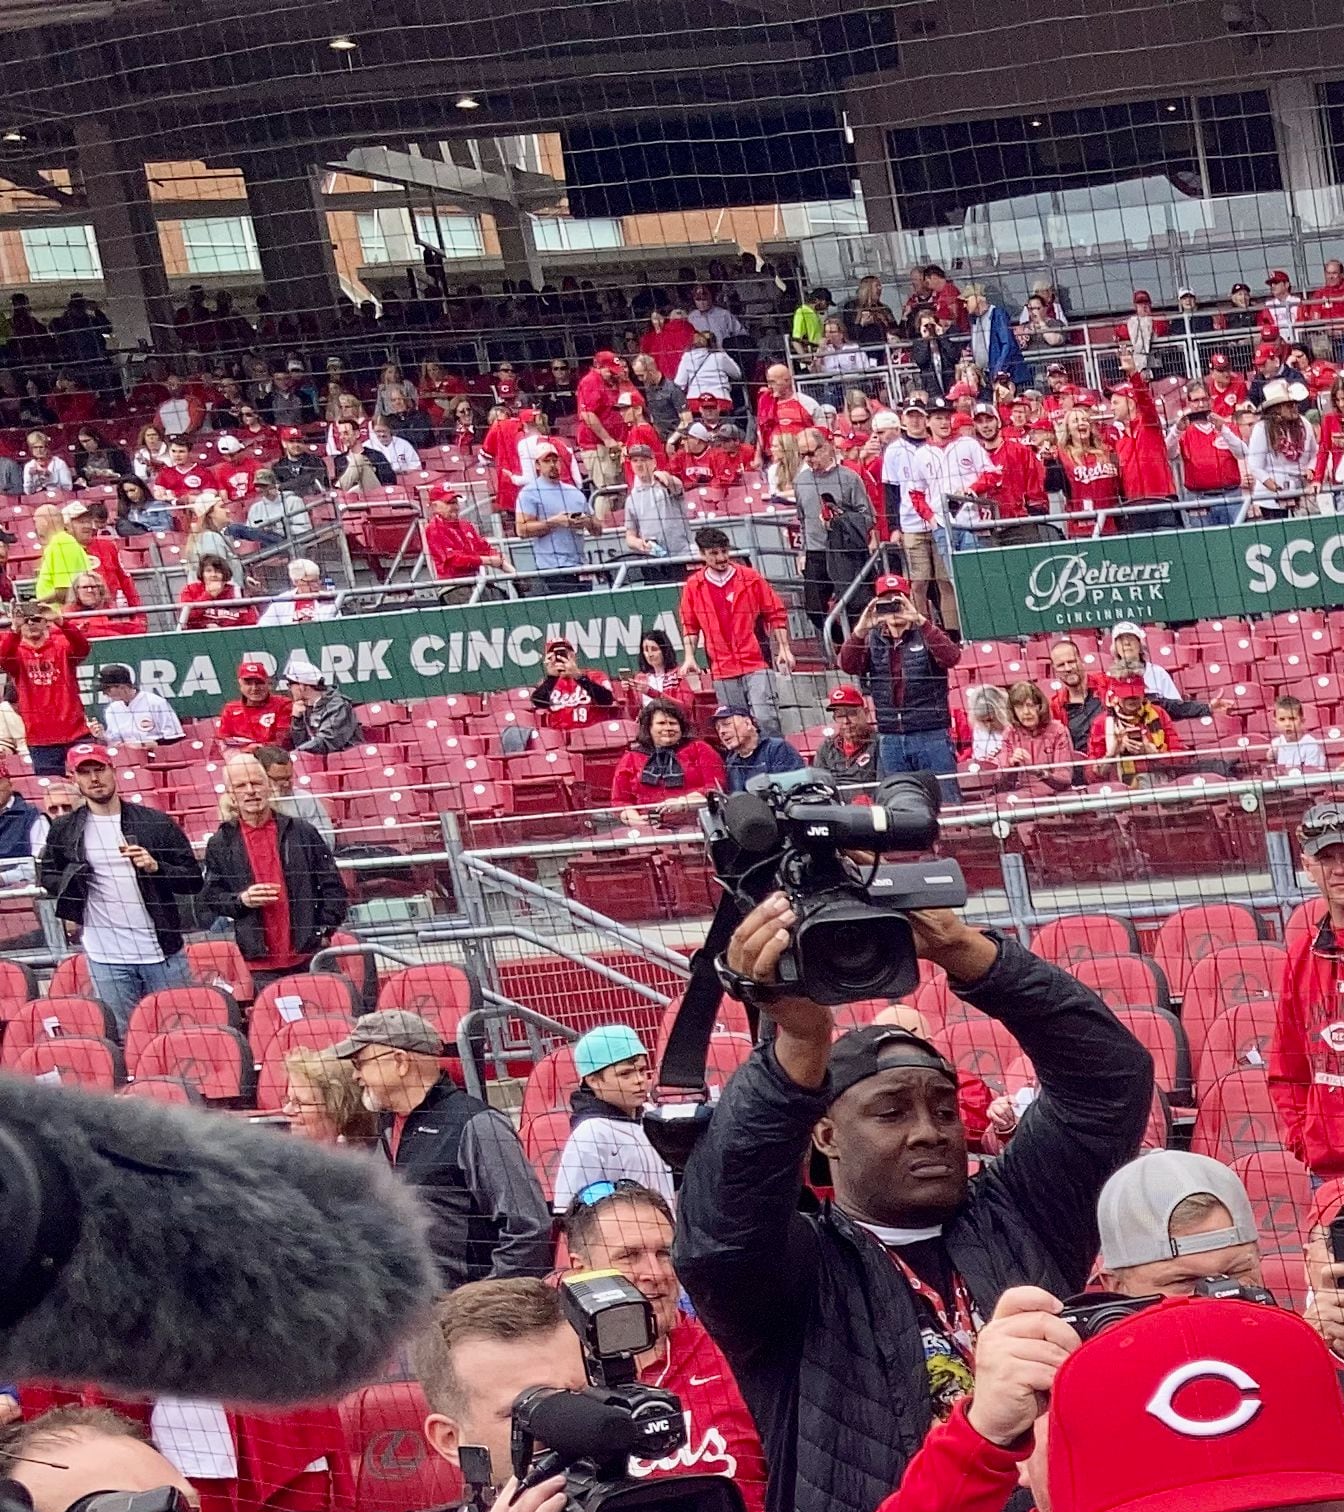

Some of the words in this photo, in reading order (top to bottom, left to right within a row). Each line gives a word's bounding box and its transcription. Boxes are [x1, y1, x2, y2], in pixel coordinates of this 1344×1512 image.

[1025, 552, 1173, 612] Belterra
[1091, 585, 1166, 606] PARK
[1065, 607, 1144, 625] CINCINNATI
[807, 826, 829, 836] JVC
[1146, 1359, 1263, 1437] C
[644, 1419, 670, 1435] JVC
